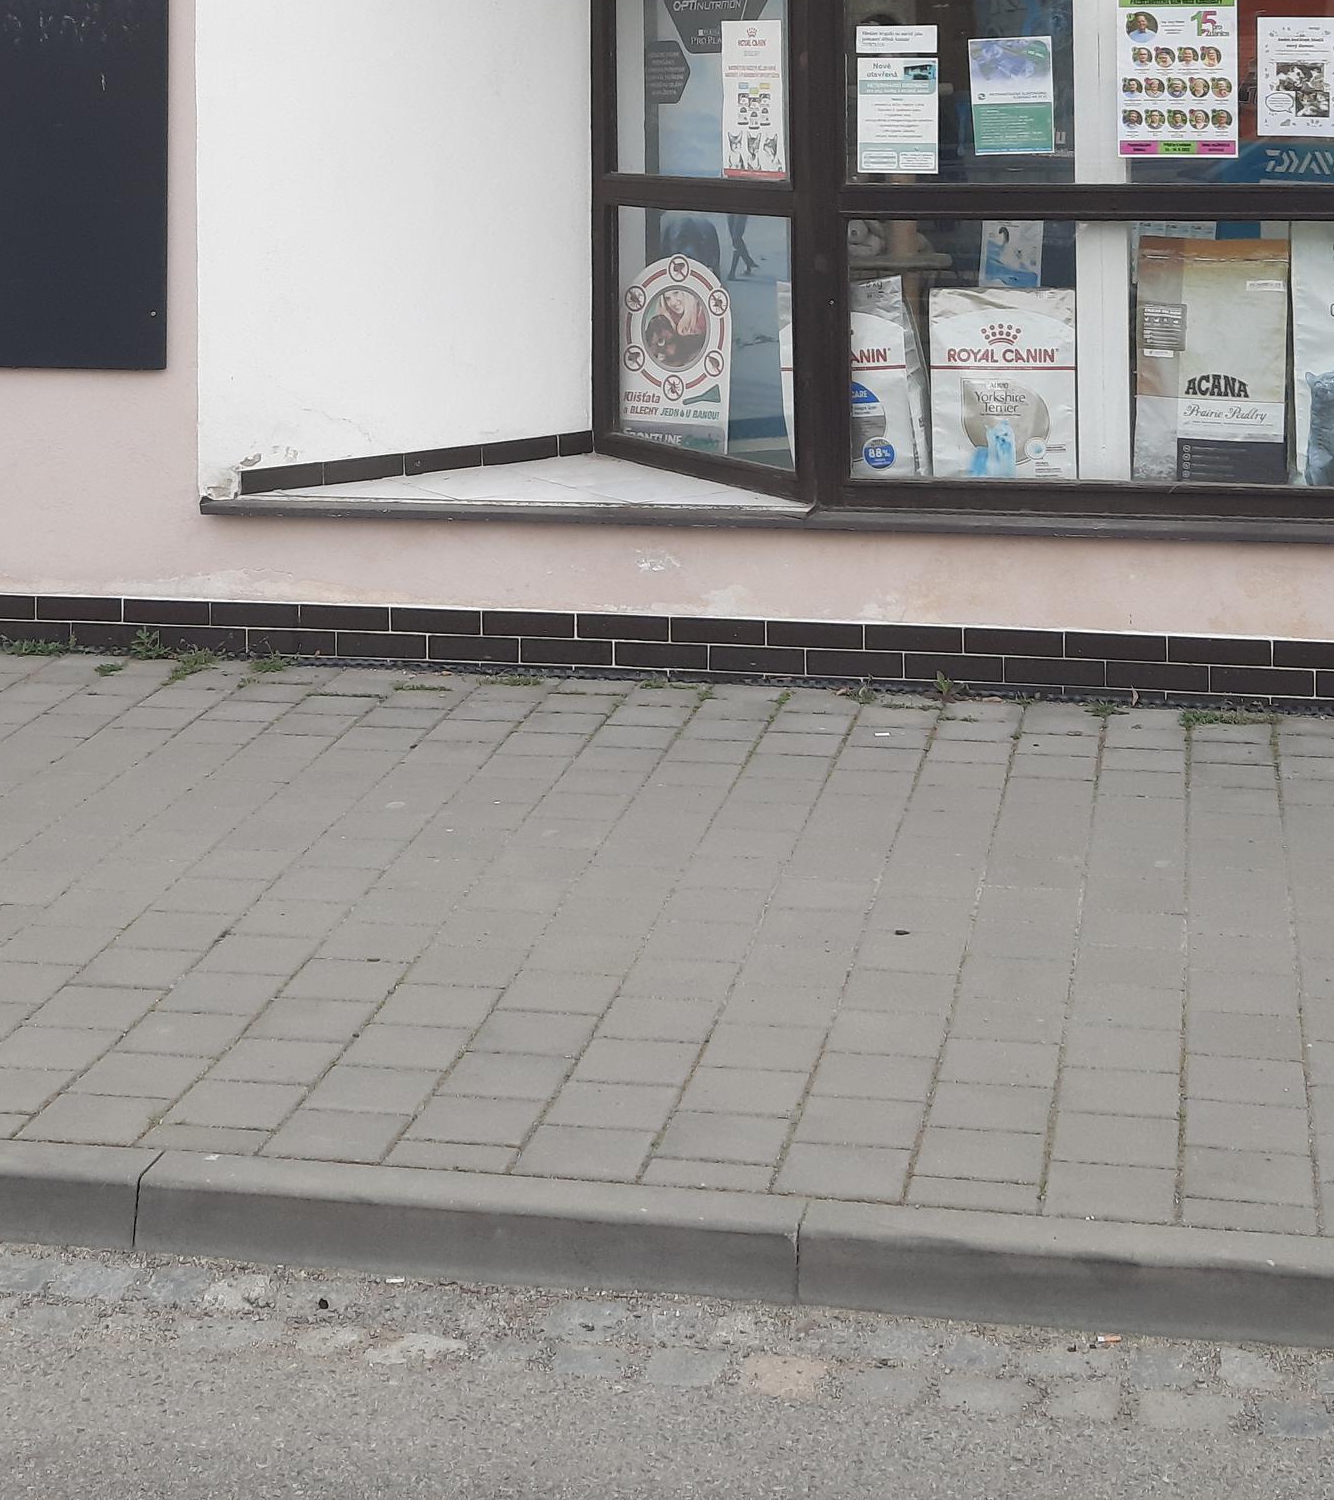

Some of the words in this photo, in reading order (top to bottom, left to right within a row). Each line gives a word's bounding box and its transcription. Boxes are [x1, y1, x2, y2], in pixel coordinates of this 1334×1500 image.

[947, 348, 999, 363] ROYAL
[1001, 348, 1055, 363] CANIN
[1184, 374, 1249, 398] ACANA
[975, 391, 1026, 403] Yorkshire
[1183, 403, 1224, 418] Prairie
